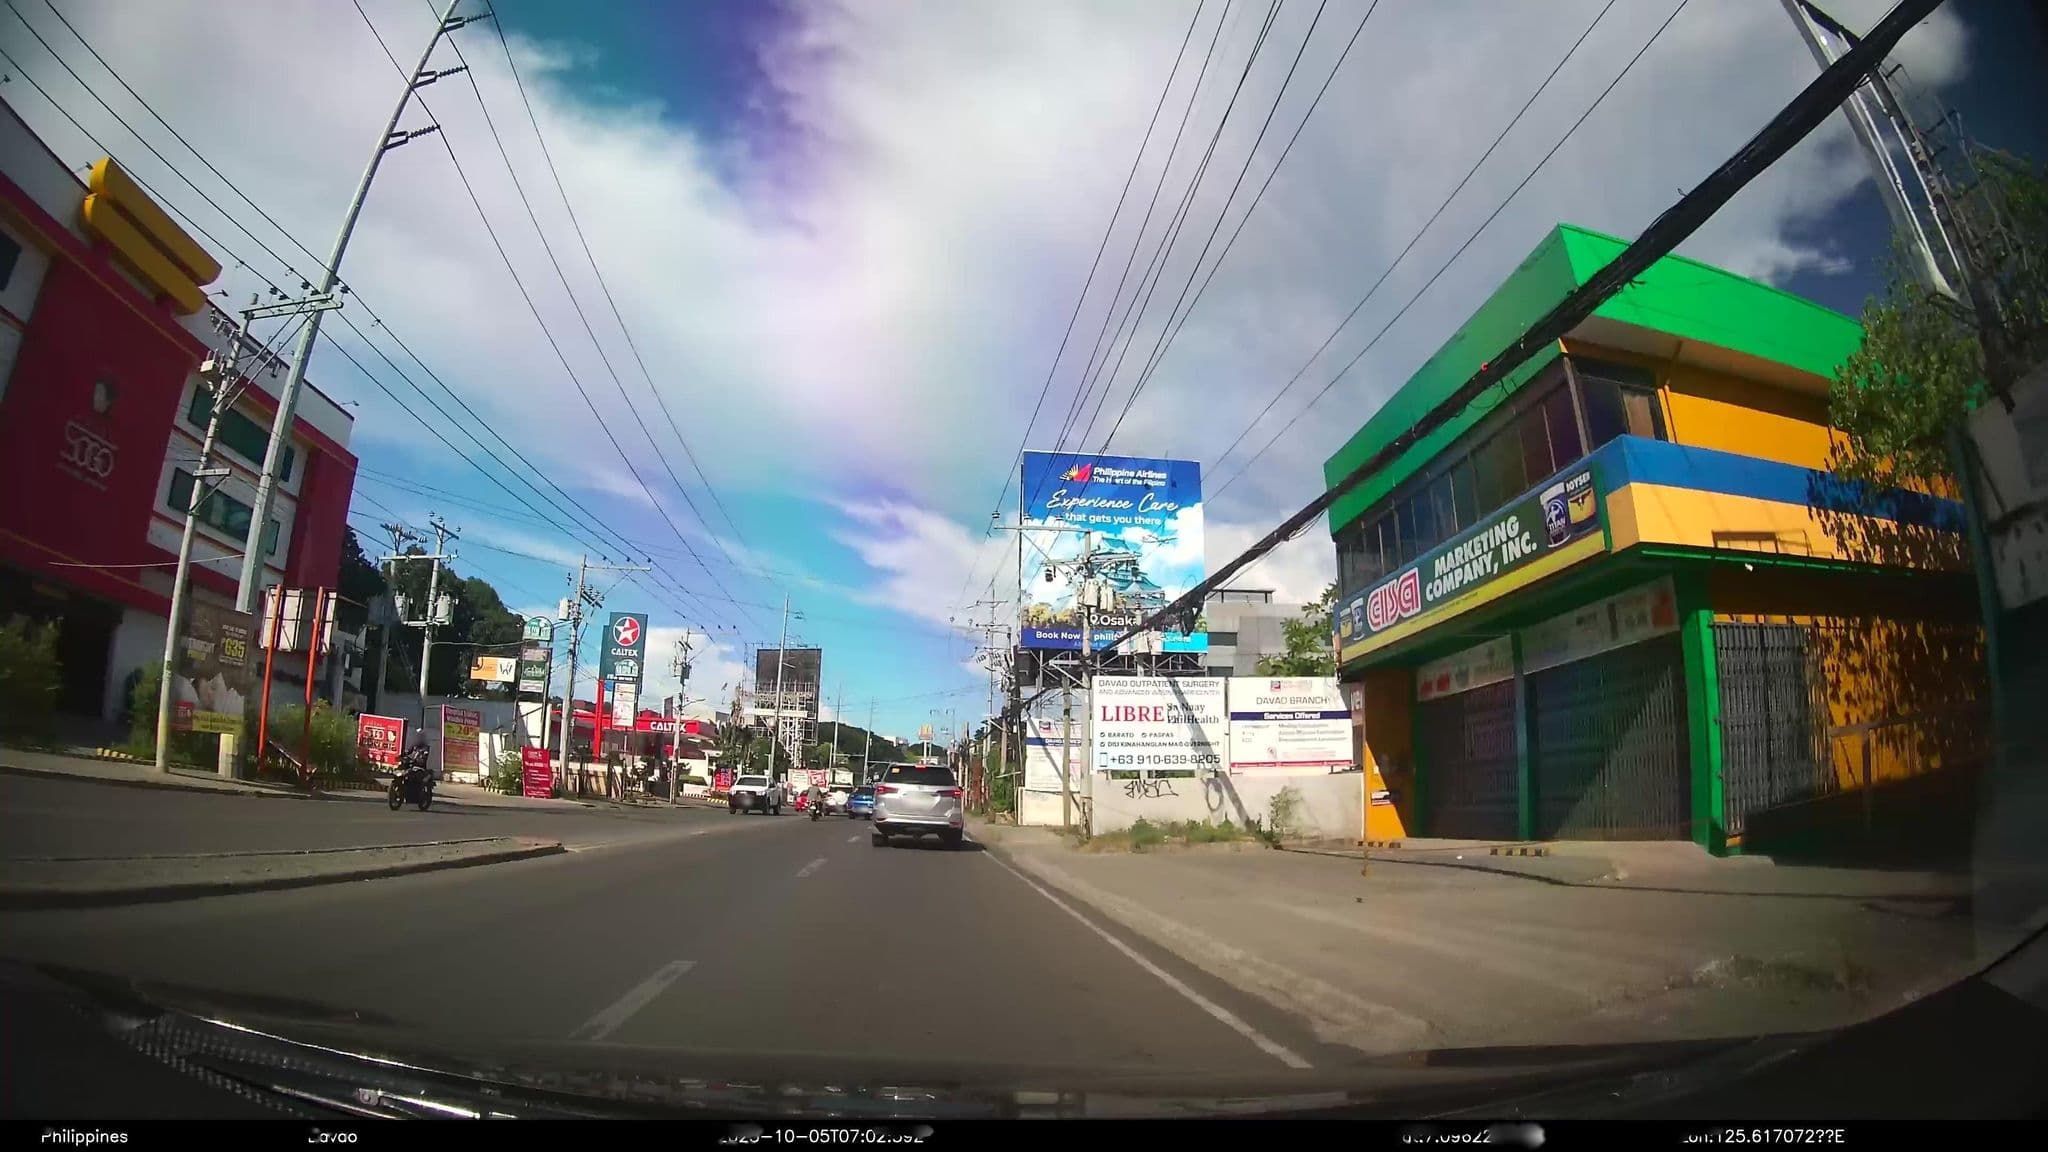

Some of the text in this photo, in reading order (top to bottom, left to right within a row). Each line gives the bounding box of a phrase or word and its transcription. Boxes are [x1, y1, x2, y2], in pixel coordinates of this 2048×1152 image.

[1093, 466, 1168, 480] Philippine Airlines
[1093, 475, 1105, 484] The
[1105, 476, 1126, 485] Hart
[1132, 478, 1144, 487] the
[1046, 488, 1179, 513] Experience Care
[1065, 511, 1162, 528] that gets you there
[1434, 515, 1520, 578] MARKETING
[1425, 531, 1538, 602] COMPANY, INC.
[1100, 615, 1137, 626] Osaka
[1036, 630, 1081, 640] Book Now
[611, 648, 638, 657] CALTEX
[1098, 679, 1220, 688] DAVAO OUTPATIENT SURGERY
[1256, 695, 1328, 705] DAVAO BRANCH
[1101, 705, 1165, 722] LIBRE
[1166, 702, 1179, 712] Sa
[1263, 711, 1321, 720] Services Offered
[1167, 713, 1220, 724] PhilHealth
[650, 721, 687, 732] CALTX
[1110, 754, 1221, 765] +63 910-639-8205
